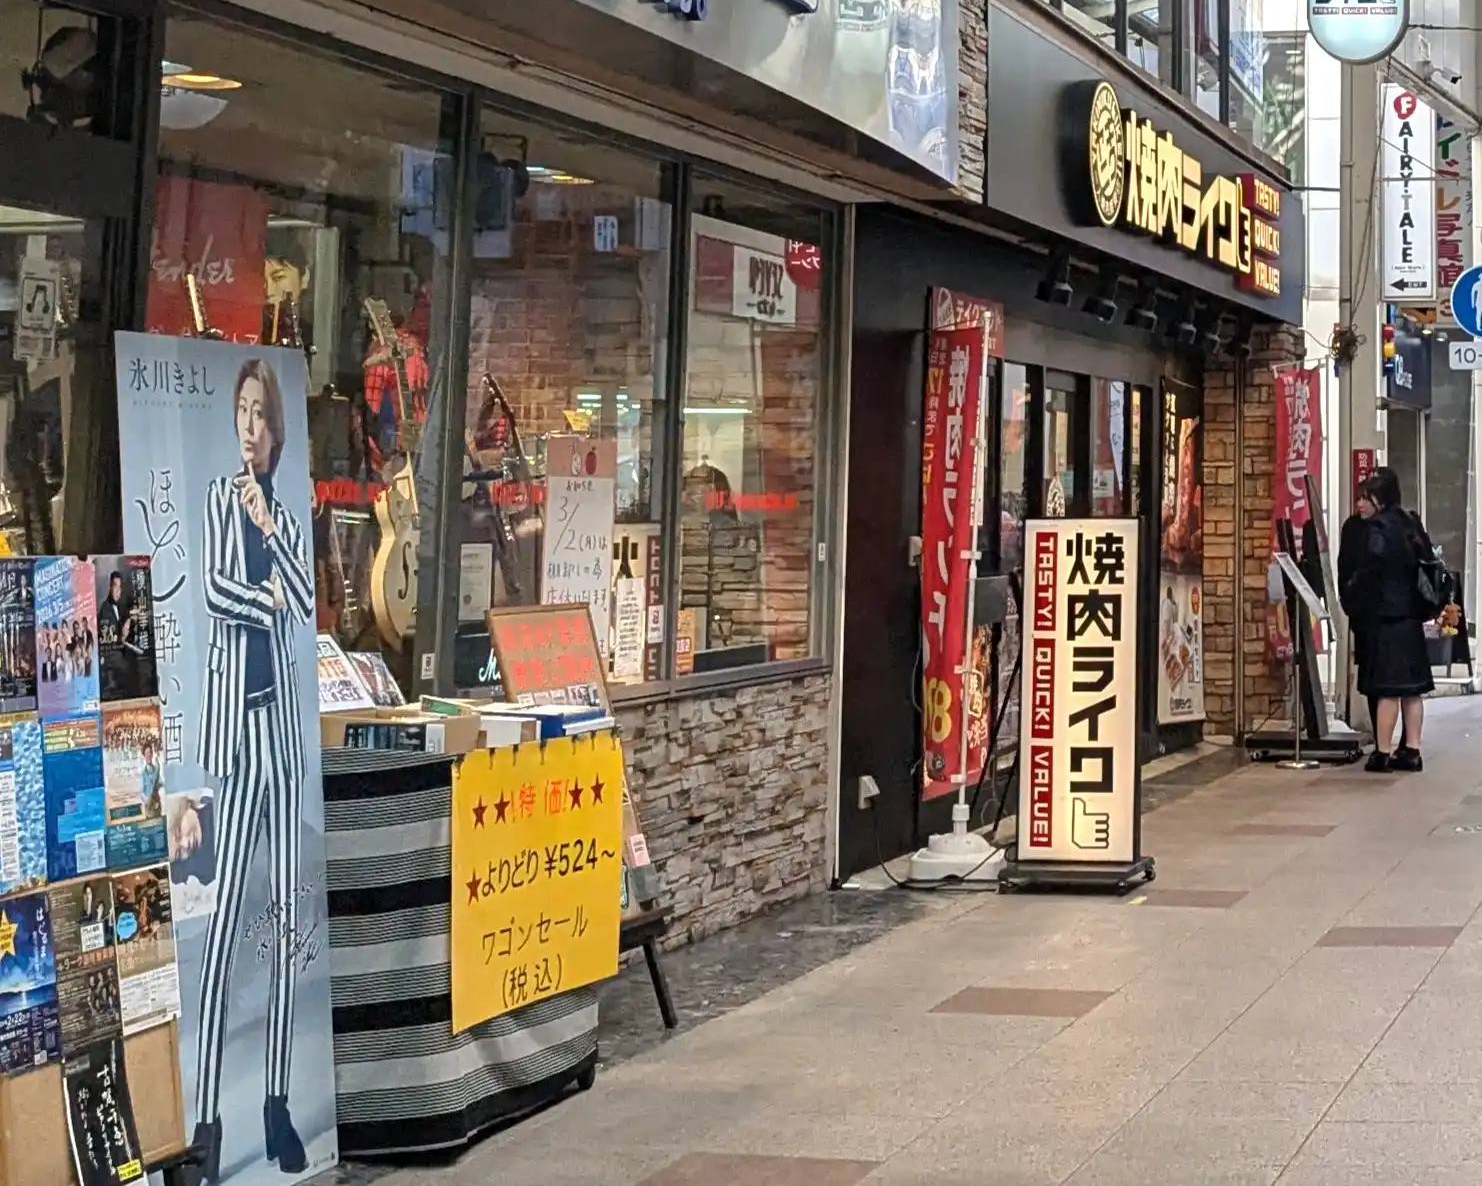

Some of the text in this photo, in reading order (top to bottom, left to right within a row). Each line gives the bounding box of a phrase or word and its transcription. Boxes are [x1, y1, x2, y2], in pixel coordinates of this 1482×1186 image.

[1125, 108, 1238, 268] 焼肉ライク
[1253, 178, 1280, 217] TASTY!
[1253, 218, 1280, 256] QUICK!
[1253, 258, 1280, 297] VALUE!
[127, 357, 217, 397] 氷川きよし
[1031, 537, 1055, 845] TASTY! QUICK! VALUE!
[1065, 532, 1126, 795] 焼肉ライク
[481, 903, 589, 966] ワゴンセール
[501, 952, 563, 1010] (税込)
